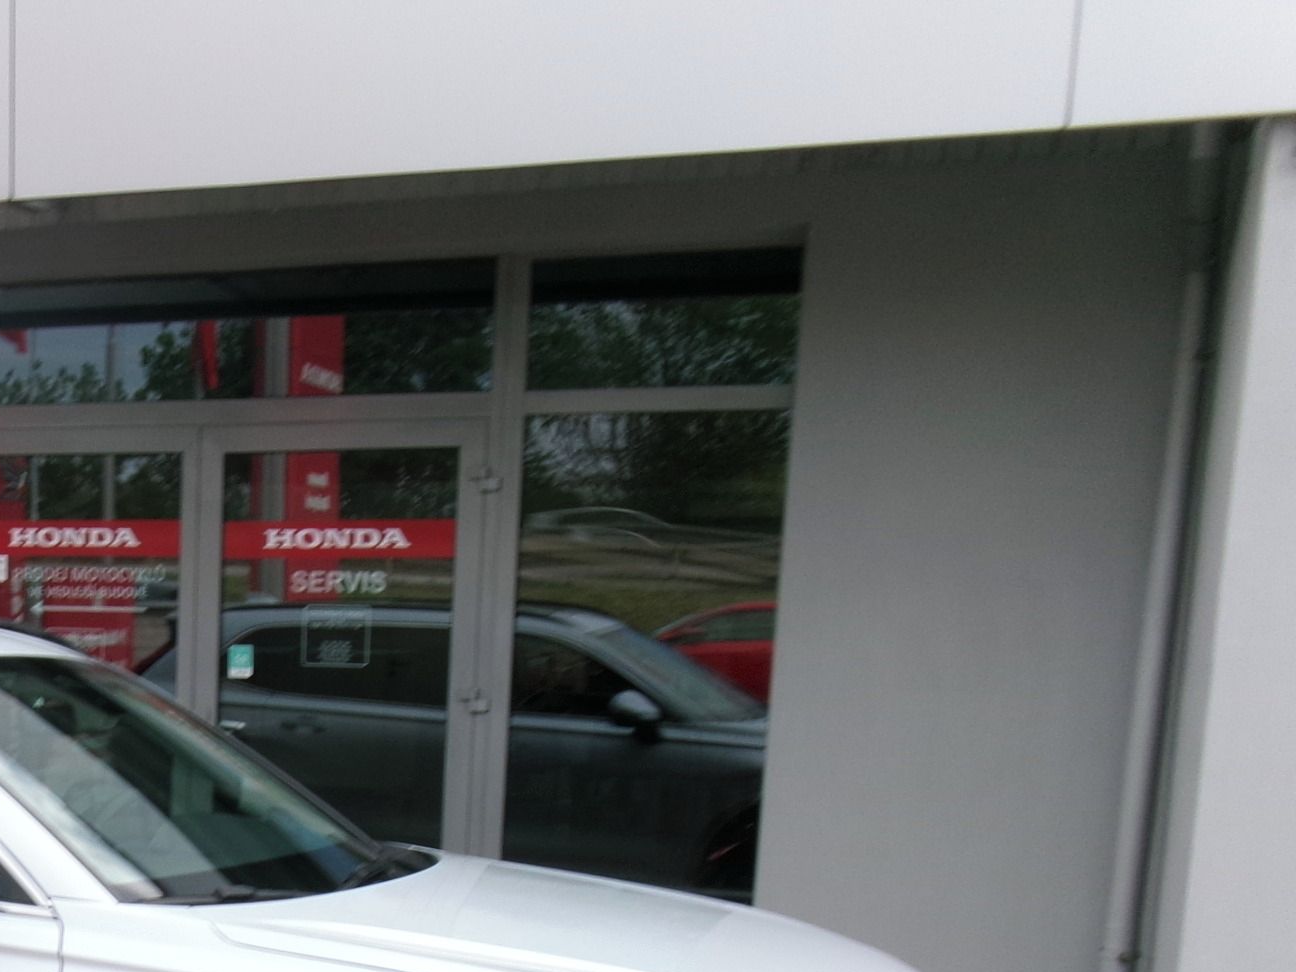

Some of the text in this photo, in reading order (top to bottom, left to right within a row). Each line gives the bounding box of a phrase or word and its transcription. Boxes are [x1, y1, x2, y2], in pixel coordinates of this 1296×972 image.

[8, 526, 141, 548] HONDA
[262, 527, 411, 550] HONDA
[290, 569, 388, 594] SERVIS
